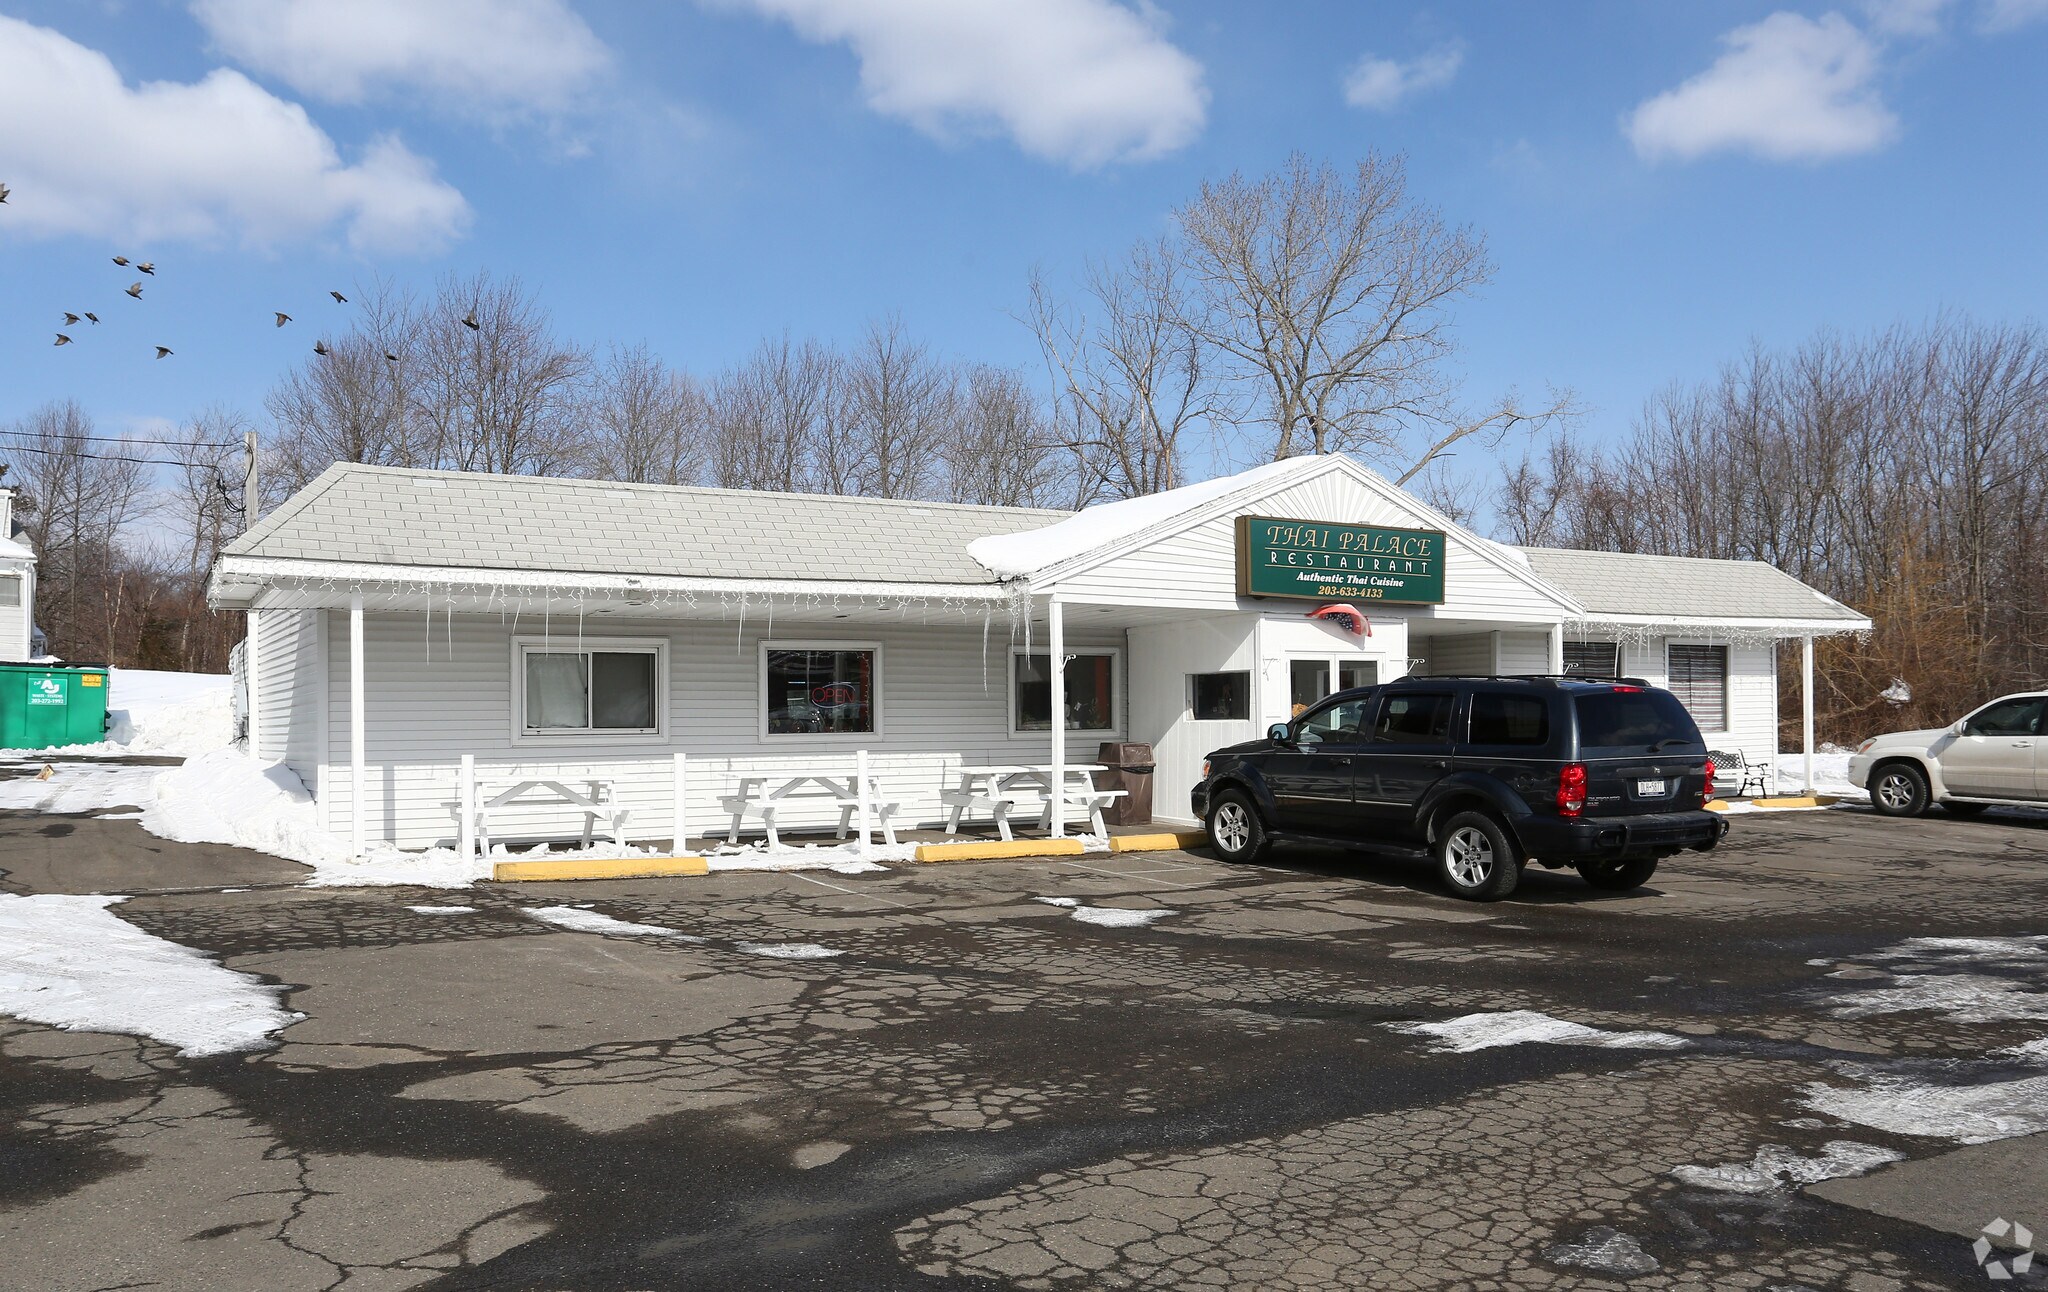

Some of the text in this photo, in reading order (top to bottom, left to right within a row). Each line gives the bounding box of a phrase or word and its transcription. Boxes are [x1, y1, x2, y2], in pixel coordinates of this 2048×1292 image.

[1266, 525, 1432, 557] THAI PALACE
[1271, 551, 1428, 574] RESTAURANT
[1296, 571, 1404, 587] Authentic Thai Cuisine
[1318, 585, 1383, 599] 203-633-4133
[812, 687, 856, 704] OPEN
